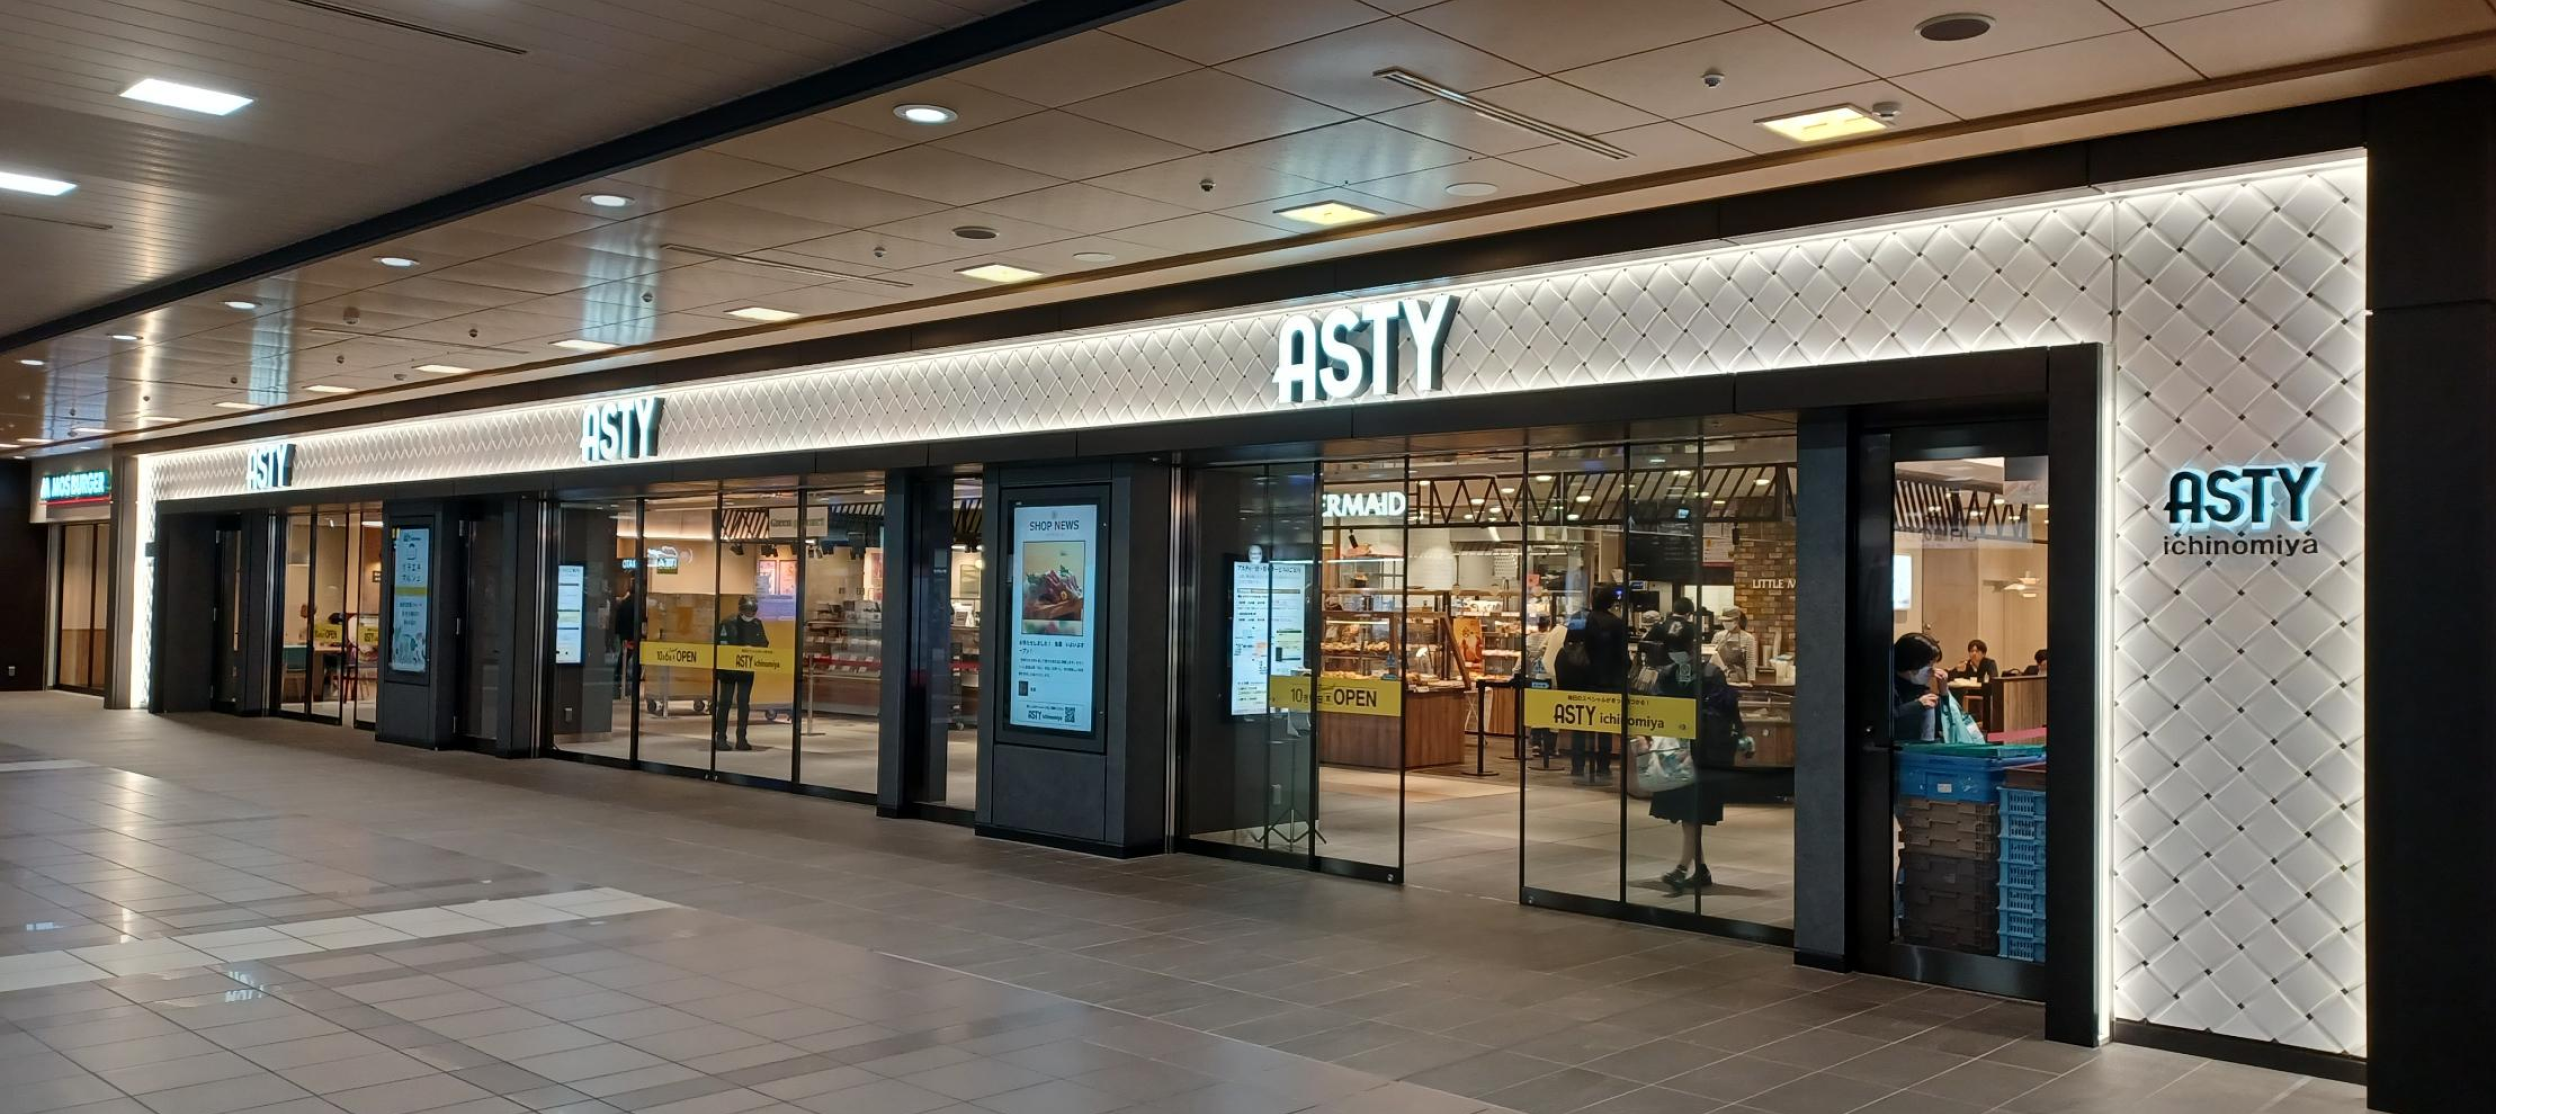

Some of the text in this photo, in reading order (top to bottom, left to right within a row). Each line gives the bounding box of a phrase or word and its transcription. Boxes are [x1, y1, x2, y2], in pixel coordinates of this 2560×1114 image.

[1272, 295, 1457, 403] ASTY
[580, 396, 661, 461] ASTY
[247, 444, 294, 490] ASTY
[52, 471, 105, 497] MOS BURGER
[2163, 466, 2319, 524] ASTY
[1029, 519, 1080, 532] SHOP NEWS
[2163, 534, 2319, 556] ichinomiya
[1752, 578, 1784, 589] LITTLE
[676, 650, 697, 663] OPEN
[735, 654, 753, 669] ASTY
[1333, 688, 1377, 708] OPEN
[1553, 703, 1597, 726] ASTY
[1600, 712, 1665, 731] ichiomiya
